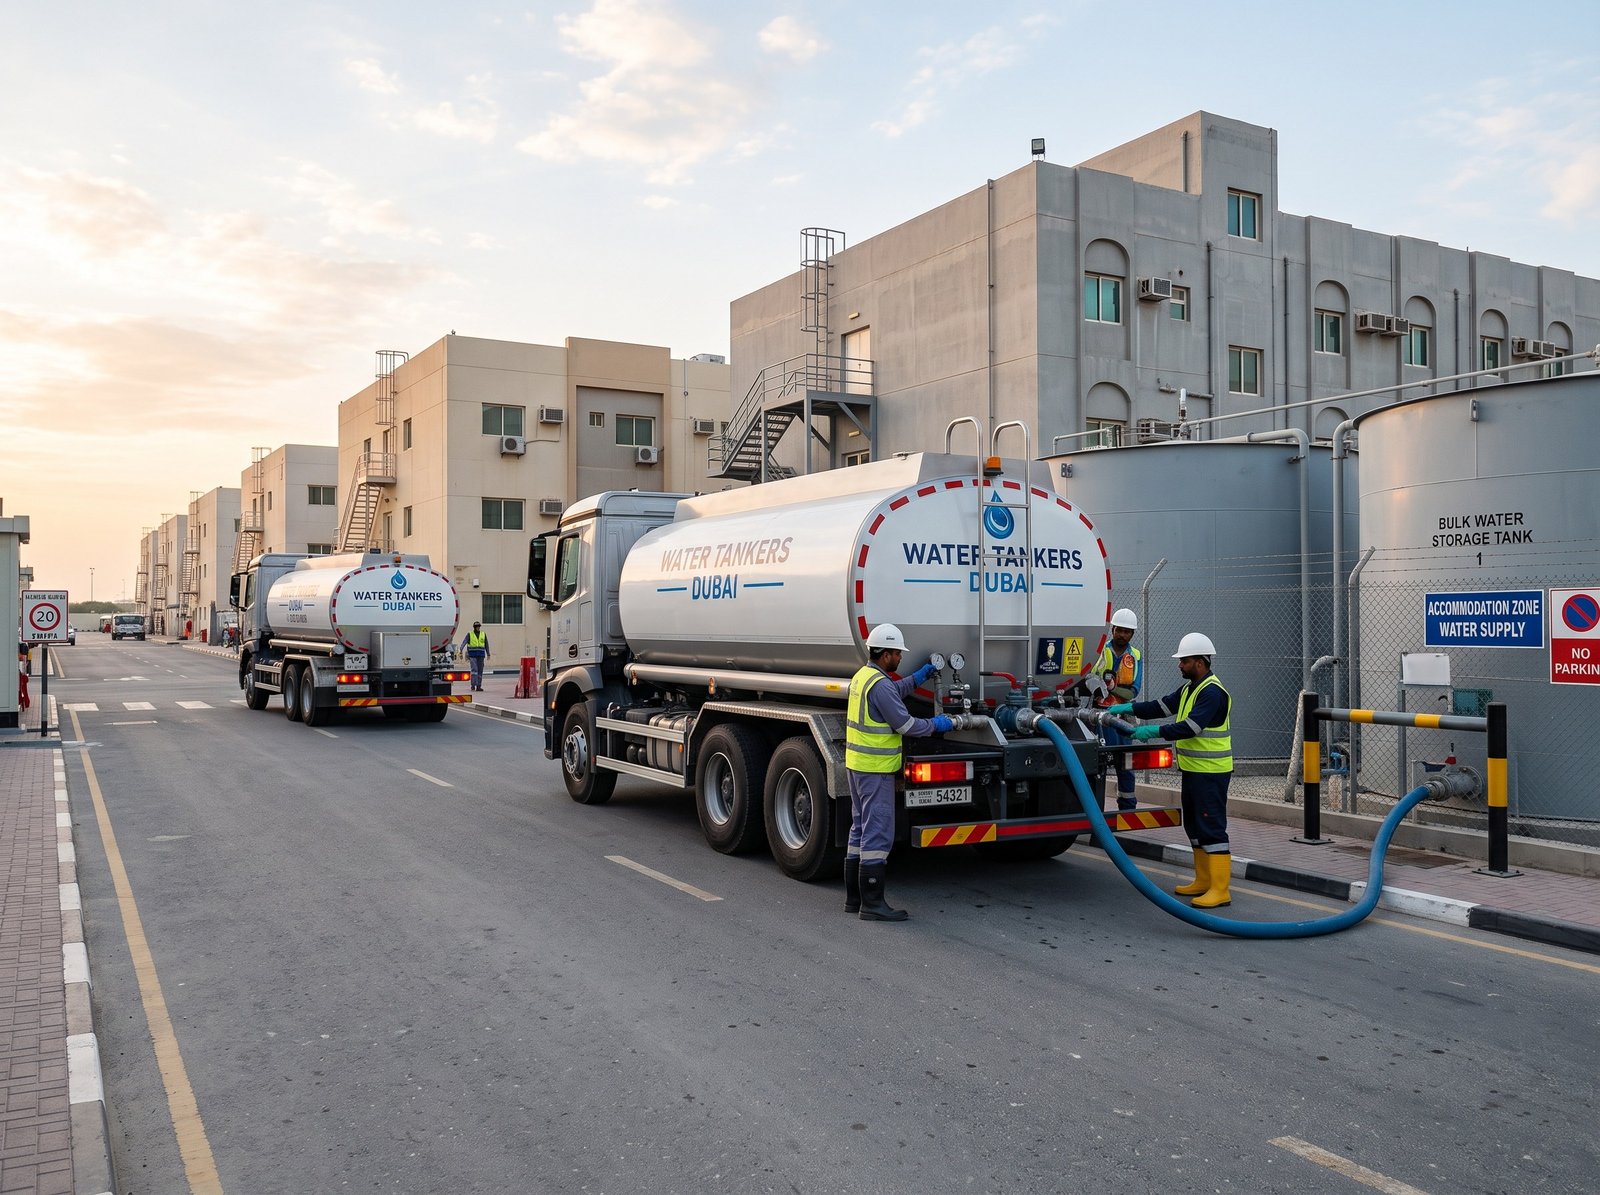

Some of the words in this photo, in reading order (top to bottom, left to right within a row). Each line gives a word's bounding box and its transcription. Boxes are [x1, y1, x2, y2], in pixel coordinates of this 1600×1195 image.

[1439, 515, 1470, 530] BULK
[1475, 512, 1524, 527] WATER
[1432, 532, 1490, 547] STORAGE
[1494, 529, 1533, 544] TANK
[661, 545, 712, 572] WATER
[714, 536, 793, 568] TANKERS
[903, 543, 986, 566] WATER
[992, 546, 1083, 570] TANKERS
[1476, 552, 1482, 566] 1
[692, 574, 738, 600] DUBAI
[353, 591, 392, 601] WATER
[395, 591, 442, 601] TANKERS
[382, 602, 415, 611] DUBAI
[1428, 601, 1509, 616] ACCOMMODATION
[1512, 600, 1539, 615] ZONE
[37, 611, 54, 622] 20
[1439, 622, 1478, 637] WATER
[1480, 621, 1526, 638] SUPPLY
[1571, 647, 1591, 660] NO
[936, 788, 968, 803] 54321
